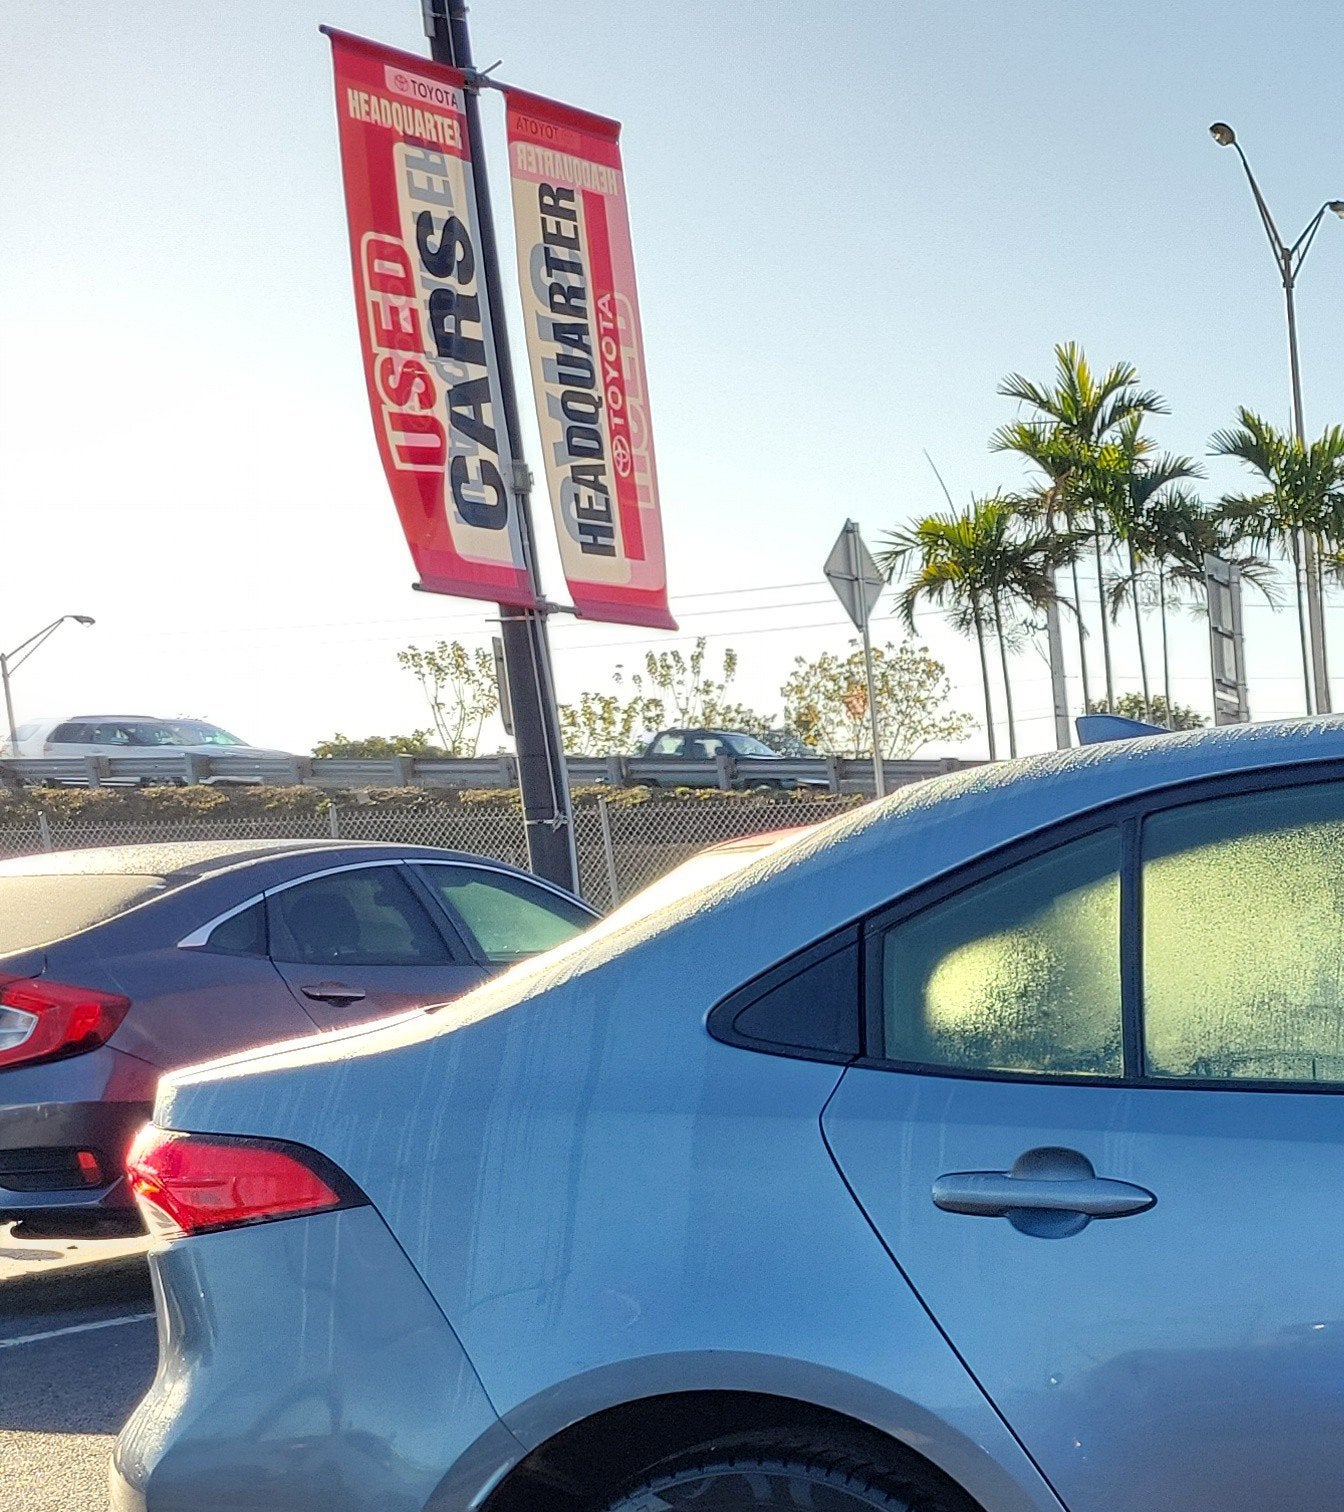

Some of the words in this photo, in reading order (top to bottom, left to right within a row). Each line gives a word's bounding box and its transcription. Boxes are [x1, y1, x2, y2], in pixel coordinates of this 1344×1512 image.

[347, 87, 463, 150] HEADQUARTER
[411, 79, 459, 109] TOYOTA
[361, 232, 447, 472] USED
[416, 210, 508, 530] CARS
[538, 182, 617, 557] HEADQUARTER
[597, 293, 625, 430] TOYOTA
